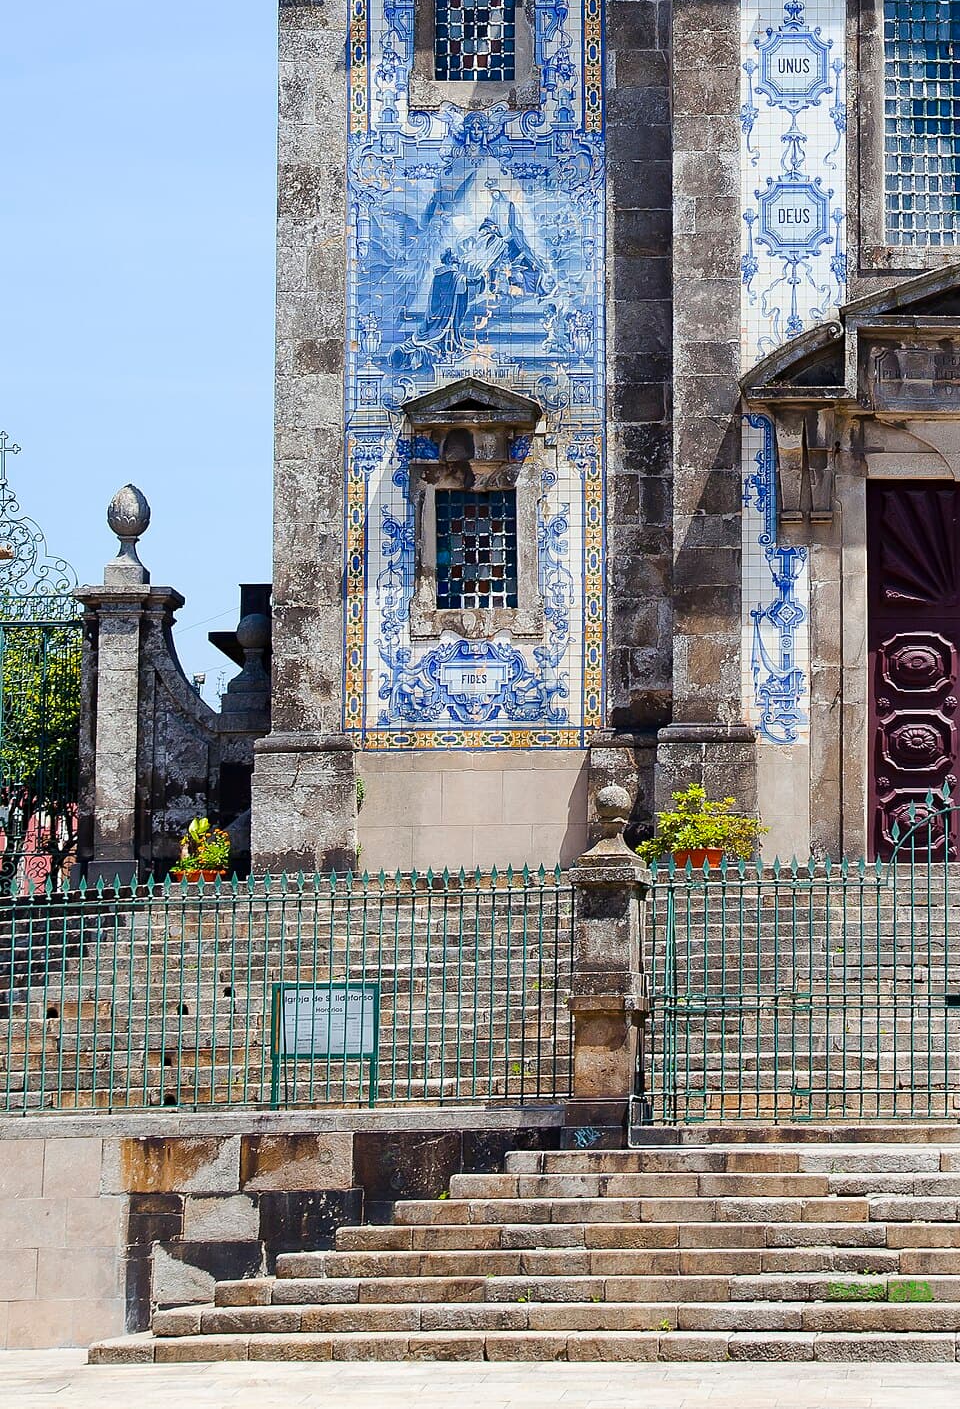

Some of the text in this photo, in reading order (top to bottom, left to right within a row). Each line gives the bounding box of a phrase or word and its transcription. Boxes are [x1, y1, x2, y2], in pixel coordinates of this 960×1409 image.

[778, 58, 810, 73] UNUS
[778, 208, 810, 224] DEUS
[494, 369, 510, 378] VIDIT
[461, 674, 487, 684] FIDES
